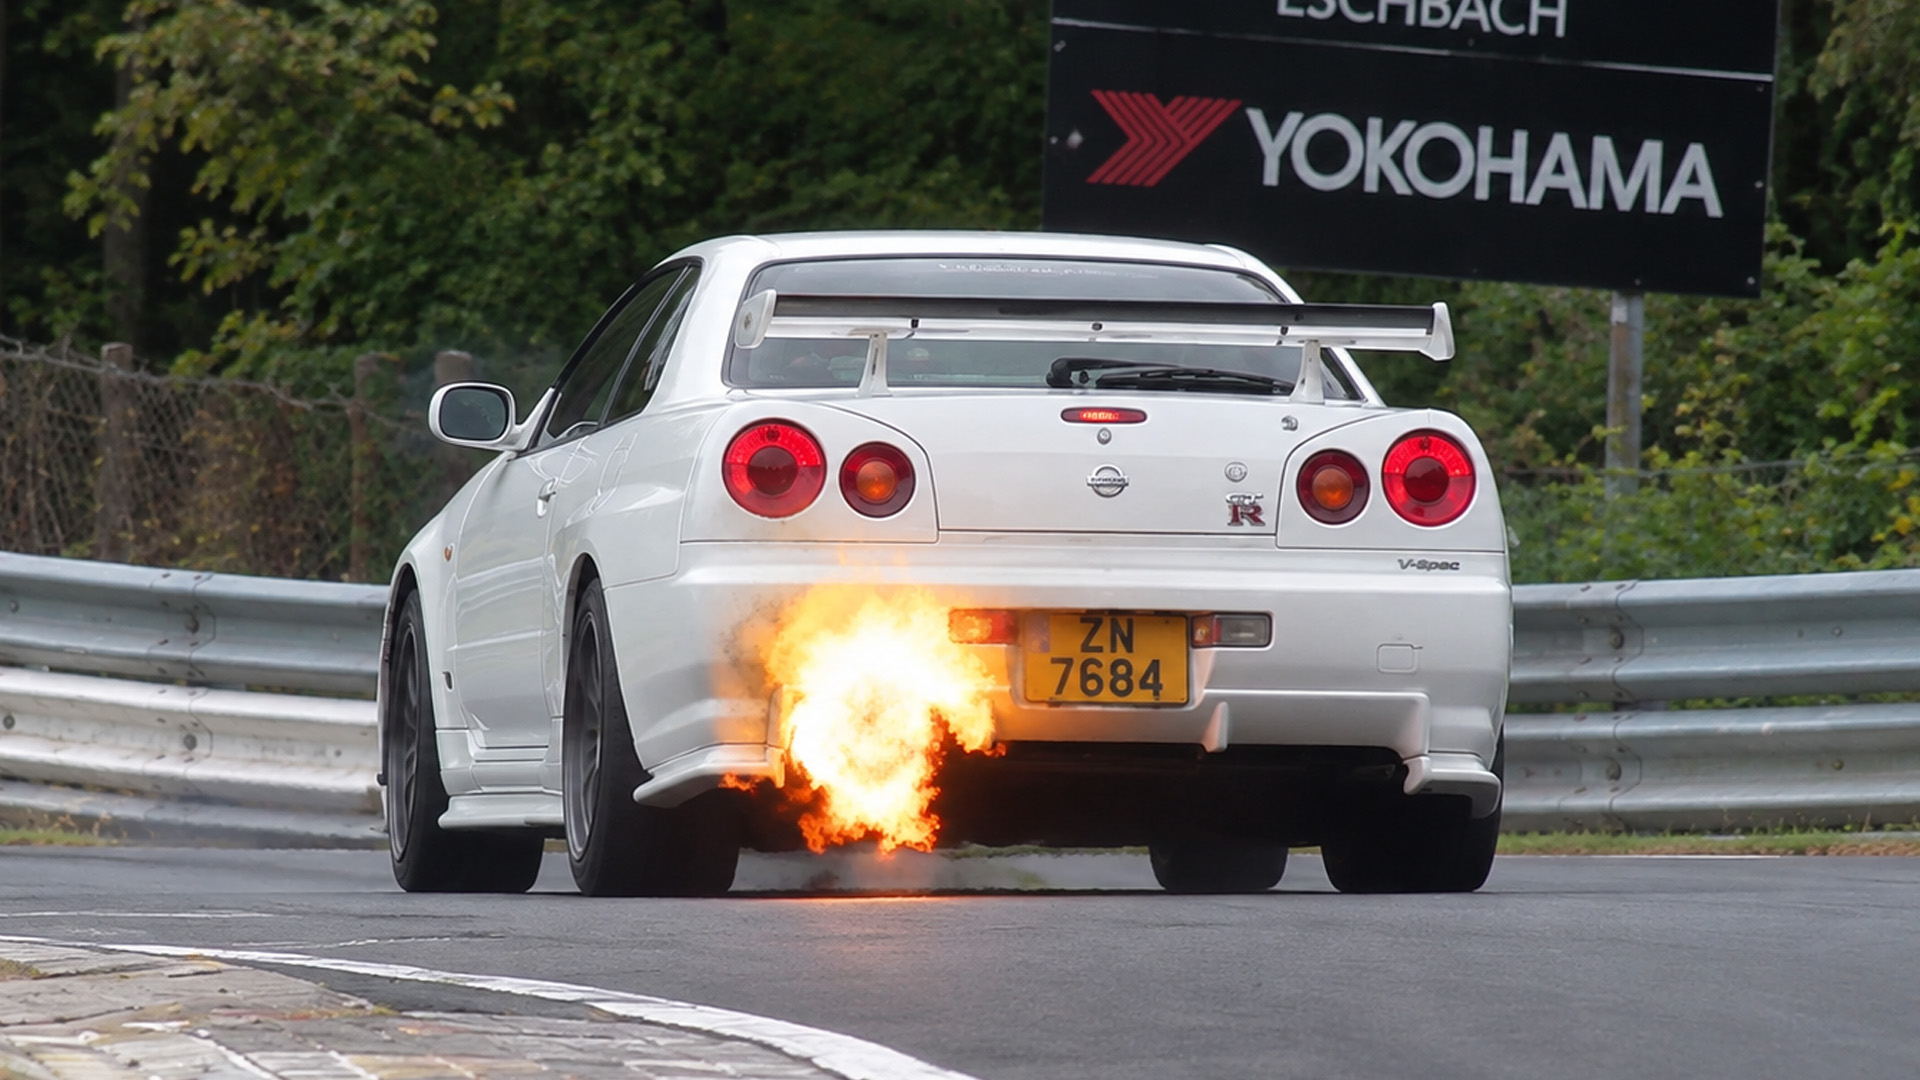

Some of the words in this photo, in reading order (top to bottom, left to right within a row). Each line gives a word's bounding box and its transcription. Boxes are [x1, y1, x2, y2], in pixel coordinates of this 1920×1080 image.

[1245, 107, 1723, 218] YOKOHAMA
[1079, 616, 1135, 654] ZN
[1050, 657, 1163, 698] 7684
